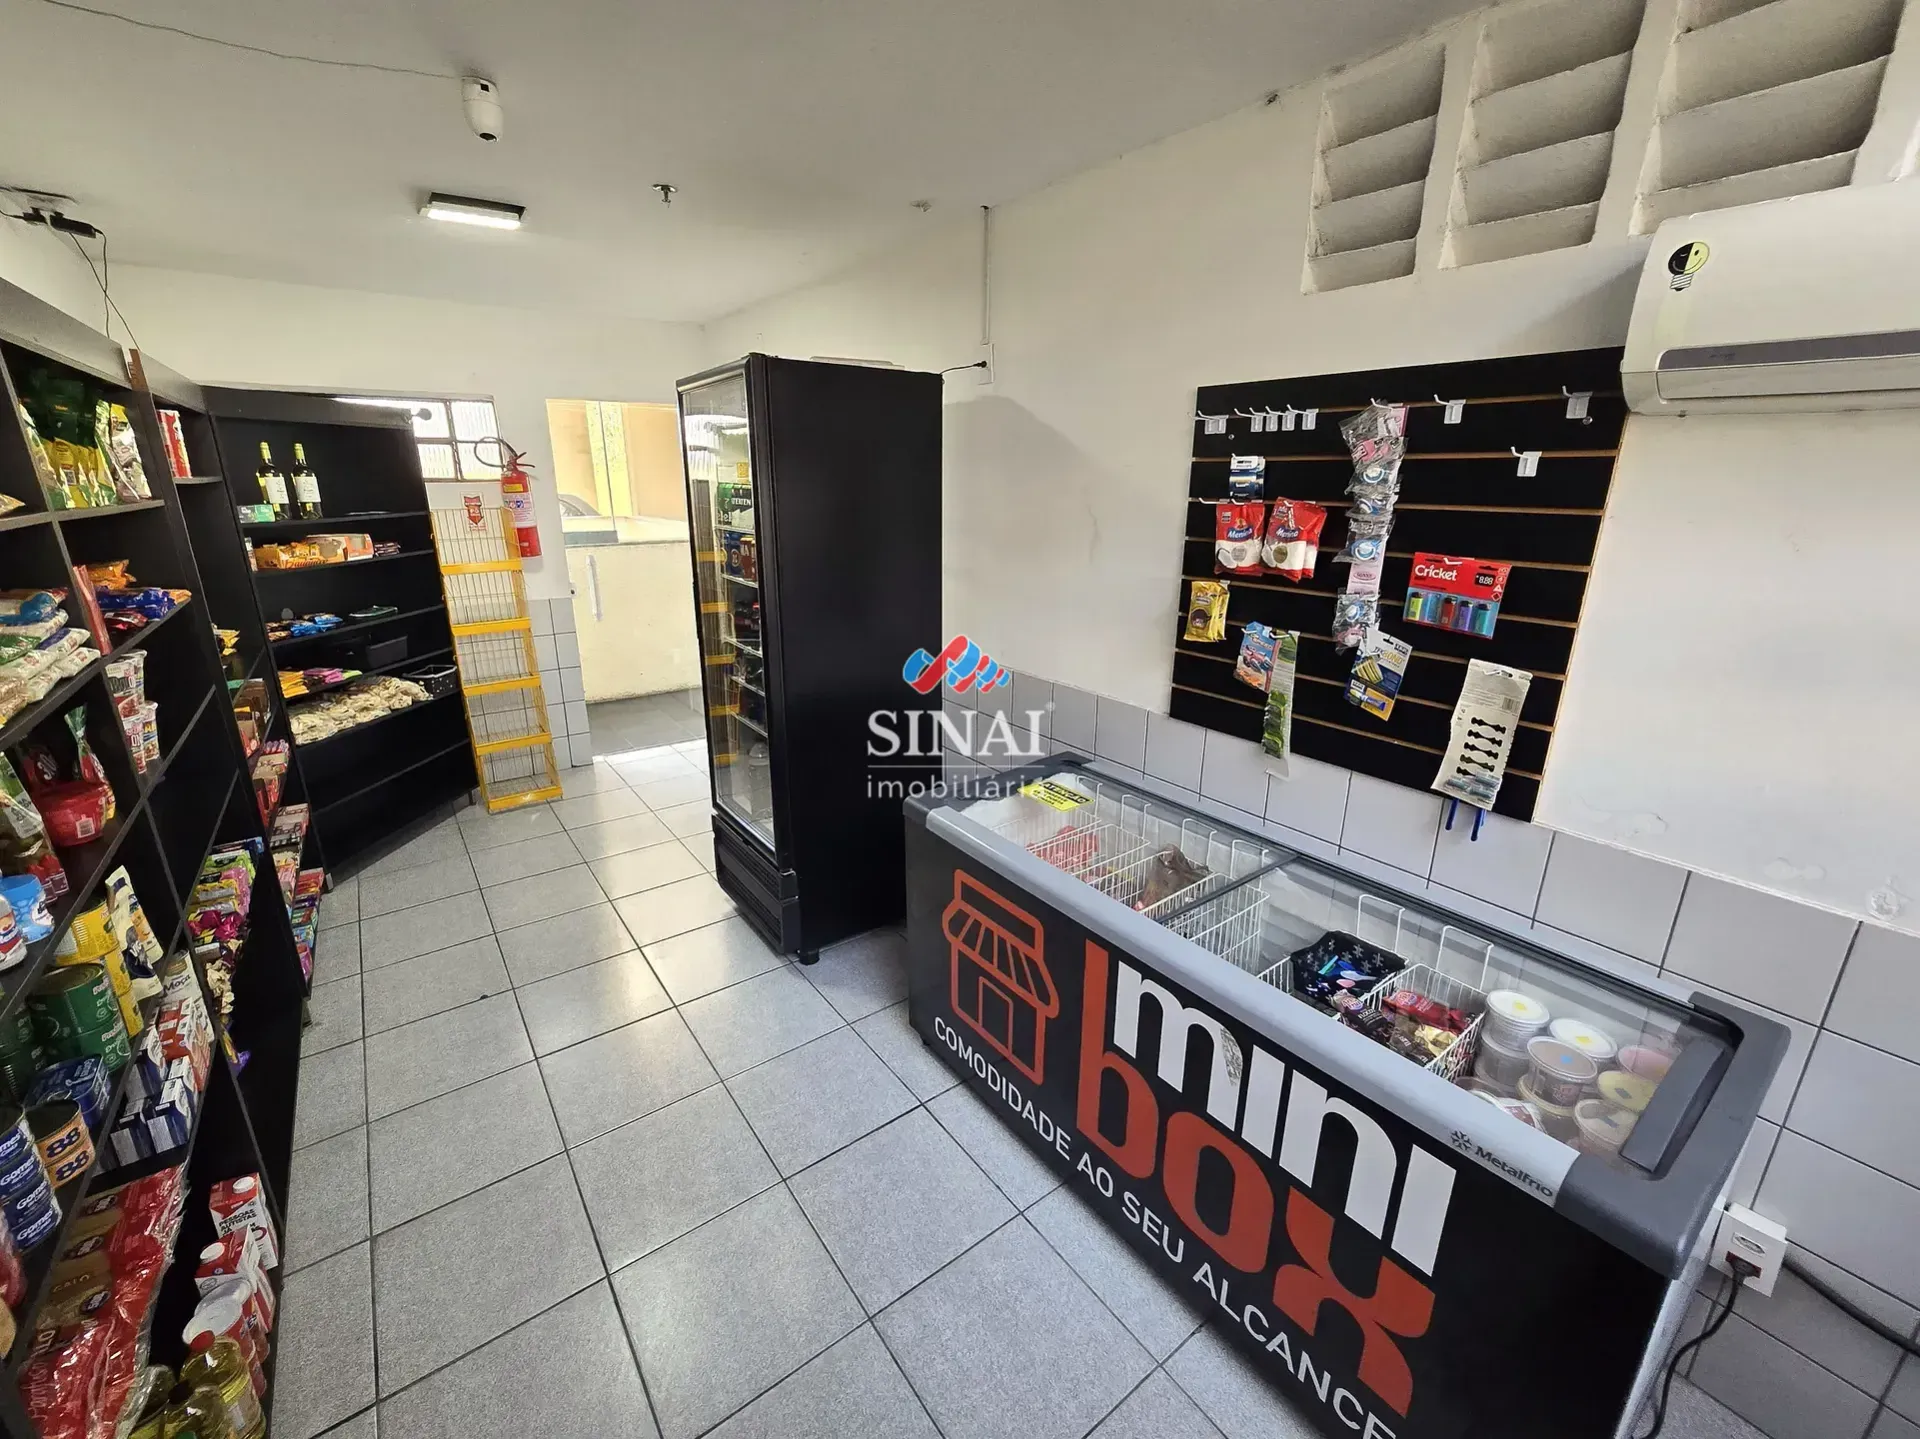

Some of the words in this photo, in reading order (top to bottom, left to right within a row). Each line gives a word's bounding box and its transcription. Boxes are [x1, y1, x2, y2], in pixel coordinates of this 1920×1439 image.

[1414, 564, 1457, 581] Cricket
[163, 974, 191, 995] Moça
[1113, 960, 1457, 1277] mini
[1076, 938, 1435, 1418] box
[1475, 1145, 1553, 1198] Metalfrio
[219, 1208, 254, 1227] PESSOAS
[220, 1213, 257, 1233] AUTISTAS
[935, 1016, 1073, 1161] COMODIDADE
[1076, 1152, 1114, 1198] AO
[1122, 1191, 1184, 1263] SEU
[1192, 1262, 1396, 1439] ALCANCE
